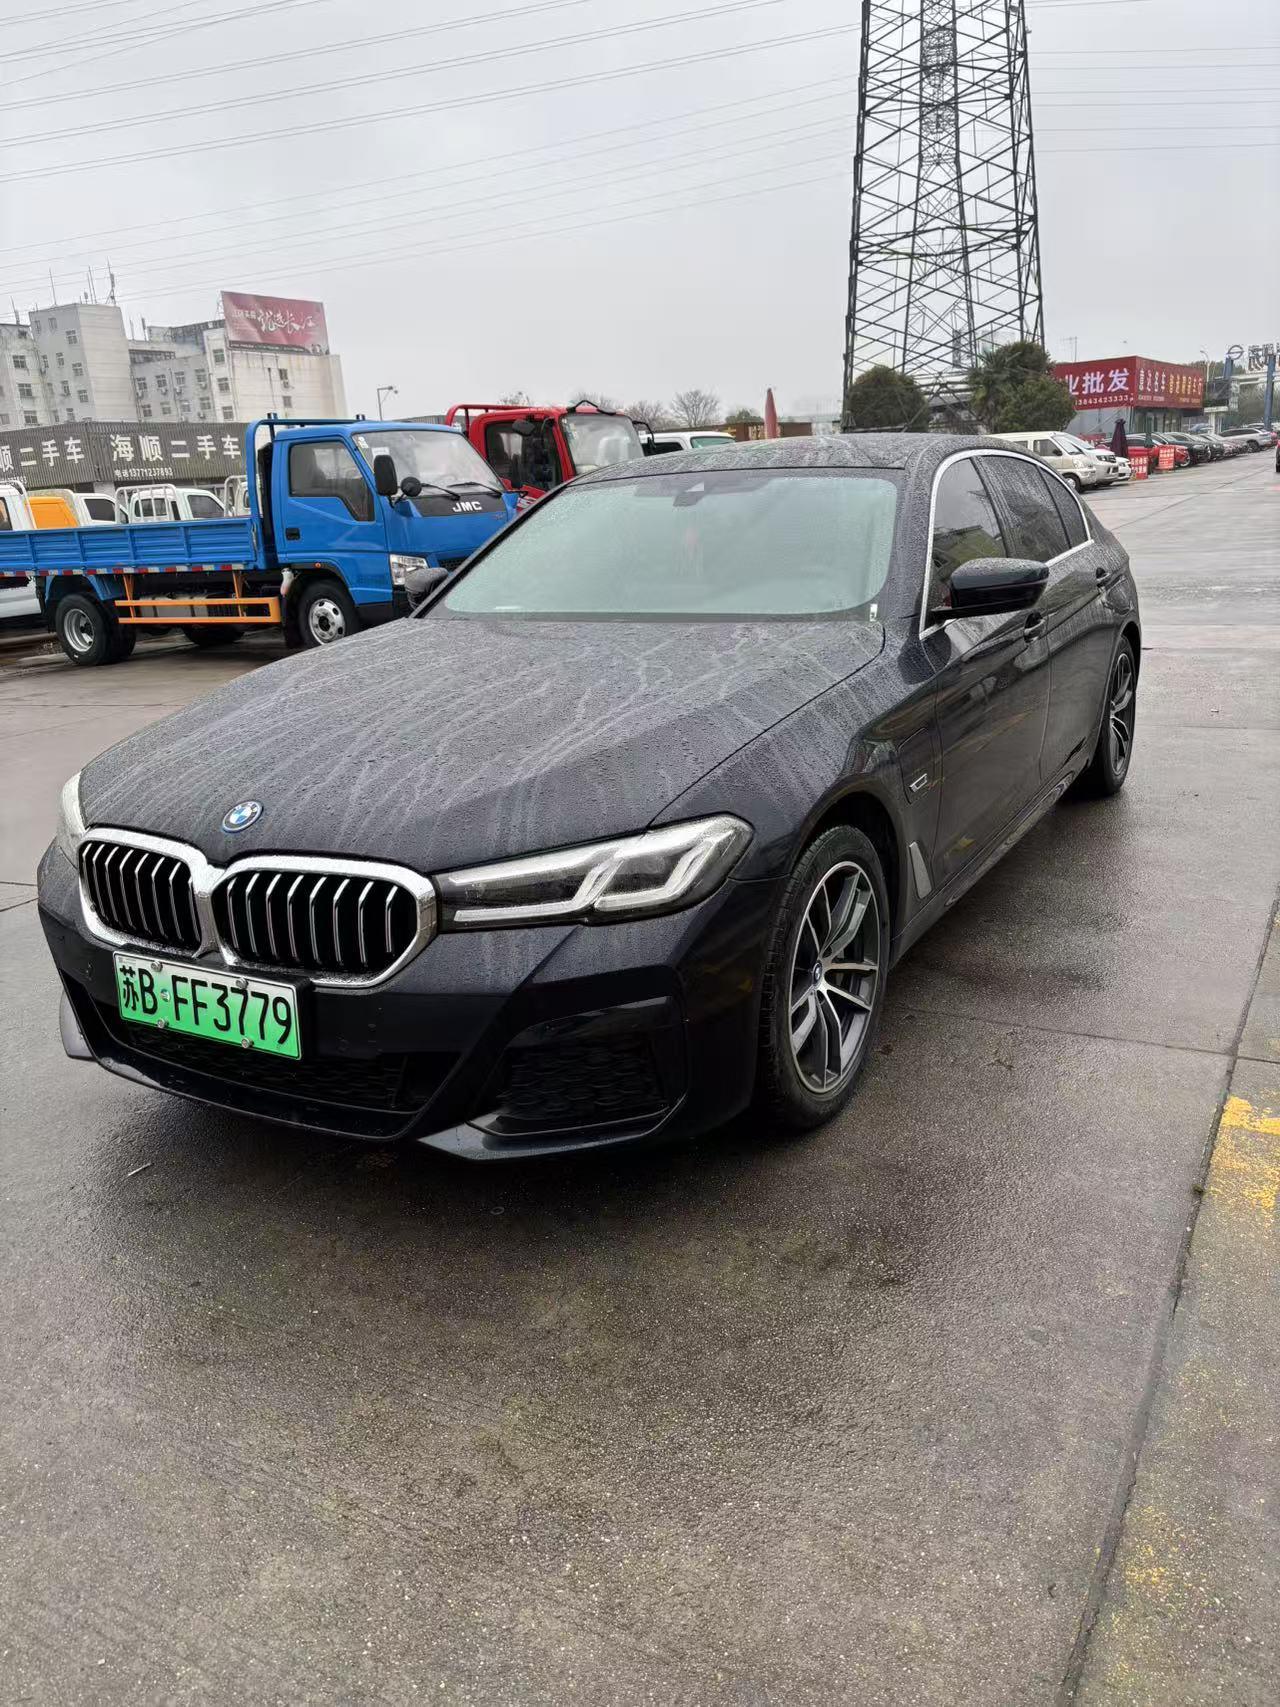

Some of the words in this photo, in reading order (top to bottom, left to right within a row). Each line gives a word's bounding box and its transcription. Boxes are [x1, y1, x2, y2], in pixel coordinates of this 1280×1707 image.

[110, 434, 241, 461] 海顺二手车
[452, 501, 482, 512] JMC
